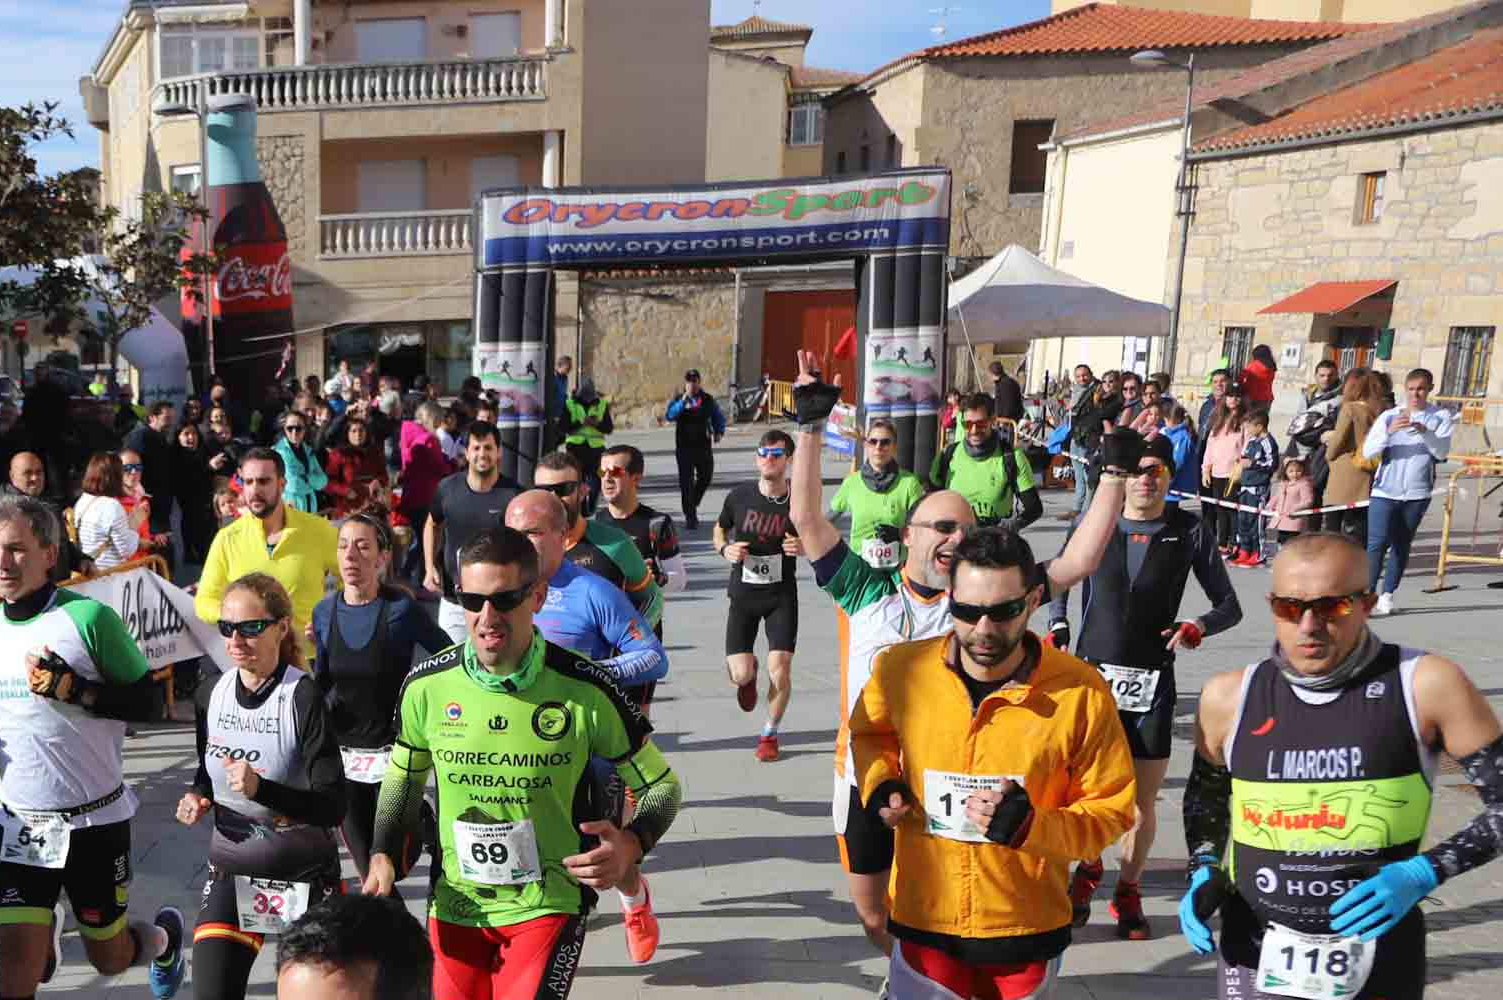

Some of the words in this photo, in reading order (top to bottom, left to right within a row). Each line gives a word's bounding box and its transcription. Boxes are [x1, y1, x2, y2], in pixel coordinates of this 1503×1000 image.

[547, 226, 889, 255] www.orycronsport.com
[741, 510, 786, 537] RUN
[868, 548, 891, 558] 108
[217, 712, 281, 735] HERNANDEZ
[352, 756, 376, 773] 27
[436, 750, 572, 767] CORRECAMINOS
[1266, 756, 1280, 779] L.
[1282, 748, 1348, 779] MARCOS
[1350, 747, 1365, 777] P.
[448, 772, 553, 790] CARBAJOSA
[469, 793, 533, 805] SALAMANCA
[18, 825, 47, 848] 54
[471, 842, 509, 865] 69
[253, 893, 285, 916] 32
[548, 945, 572, 992] AUTOS
[1281, 945, 1348, 977] 118
